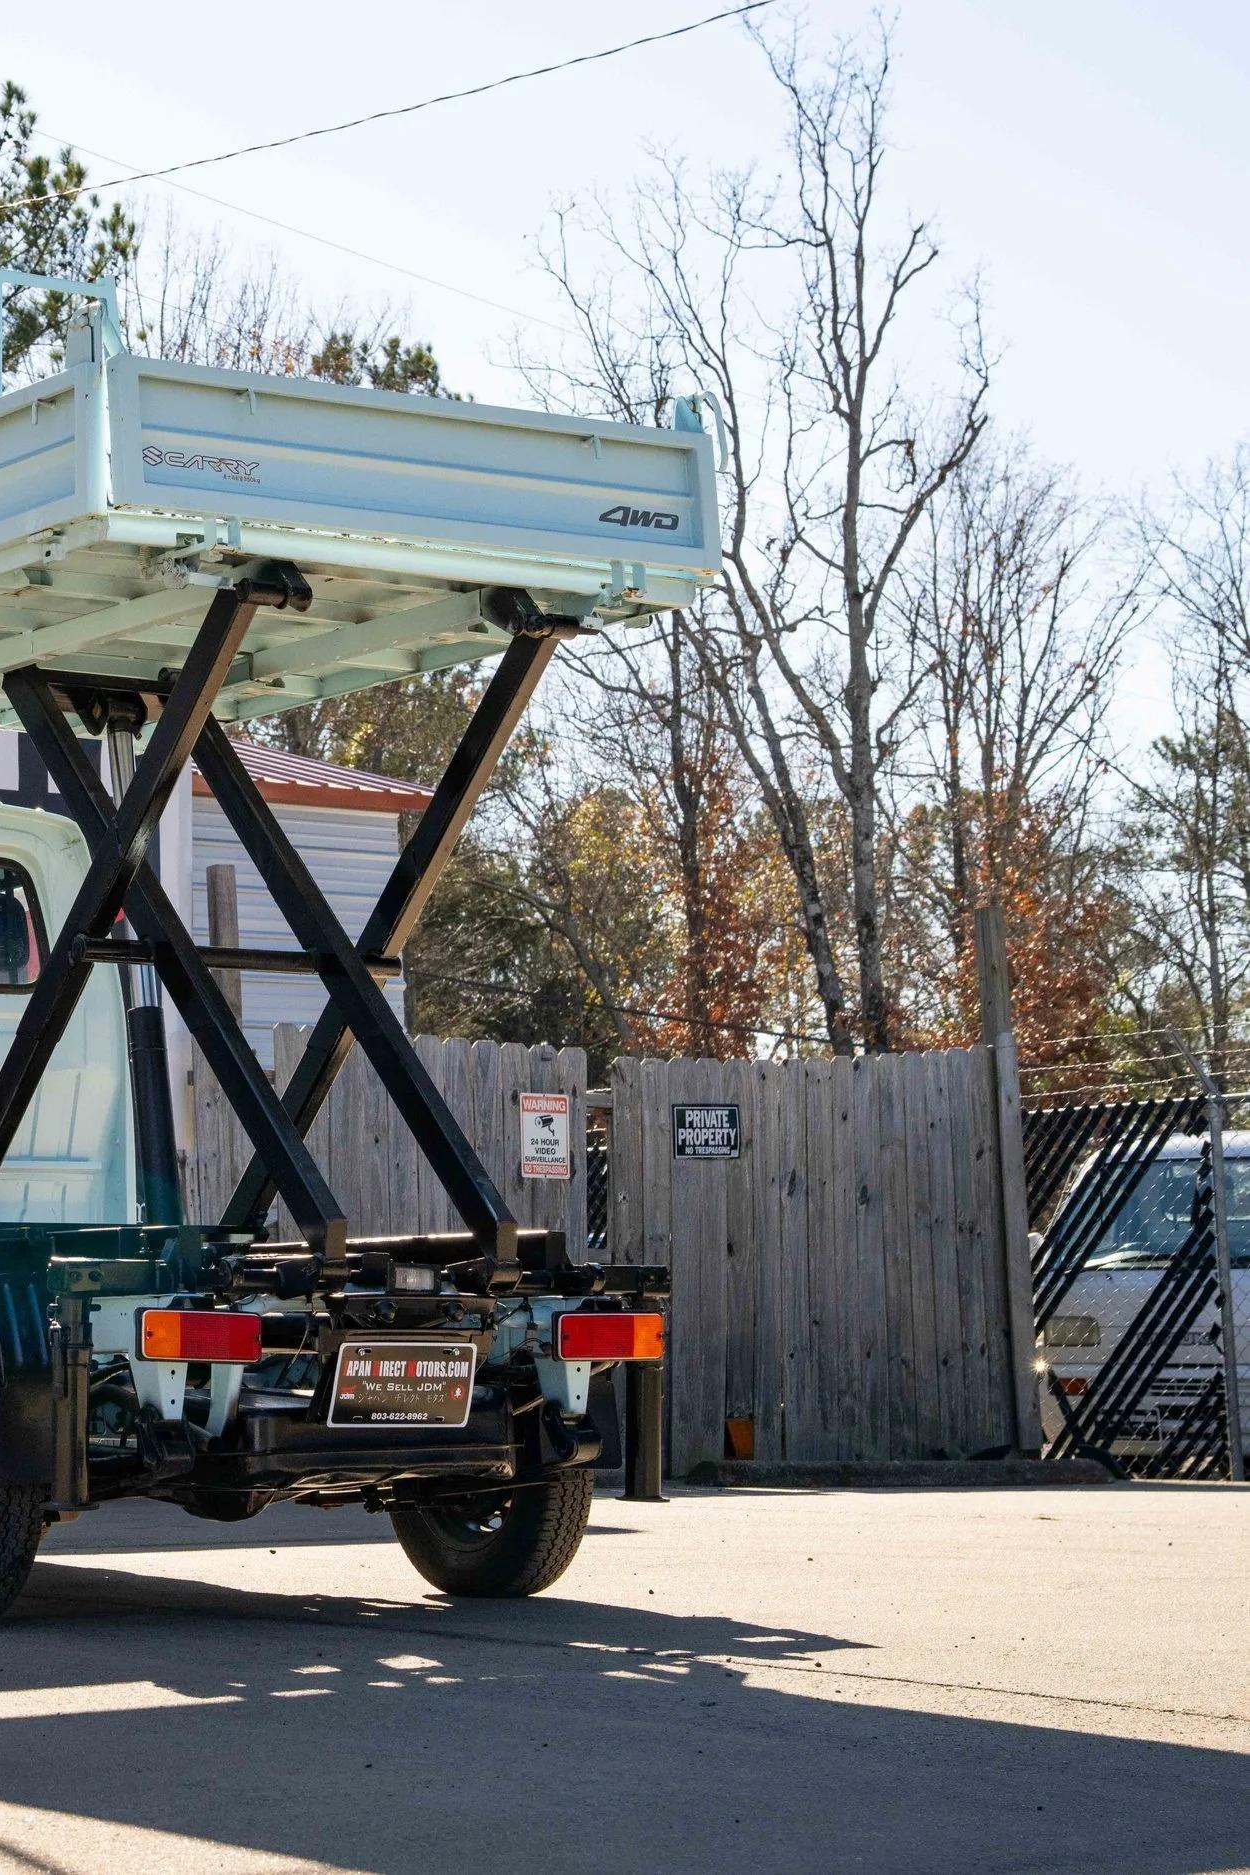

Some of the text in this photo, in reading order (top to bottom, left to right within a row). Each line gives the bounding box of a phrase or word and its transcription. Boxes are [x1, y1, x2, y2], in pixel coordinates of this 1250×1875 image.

[598, 505, 680, 531] 4WD
[523, 1098, 566, 1112] WARNING
[685, 1110, 730, 1128] PRIVATE
[678, 1128, 737, 1146] PROPERTY
[530, 1138, 560, 1146] 24 HOUR
[534, 1147, 556, 1155] VIDEO
[685, 1146, 731, 1155] NO TRESPASSING
[524, 1155, 566, 1164] SURVEILLANCE
[371, 1412, 429, 1421] 803-622-8962
